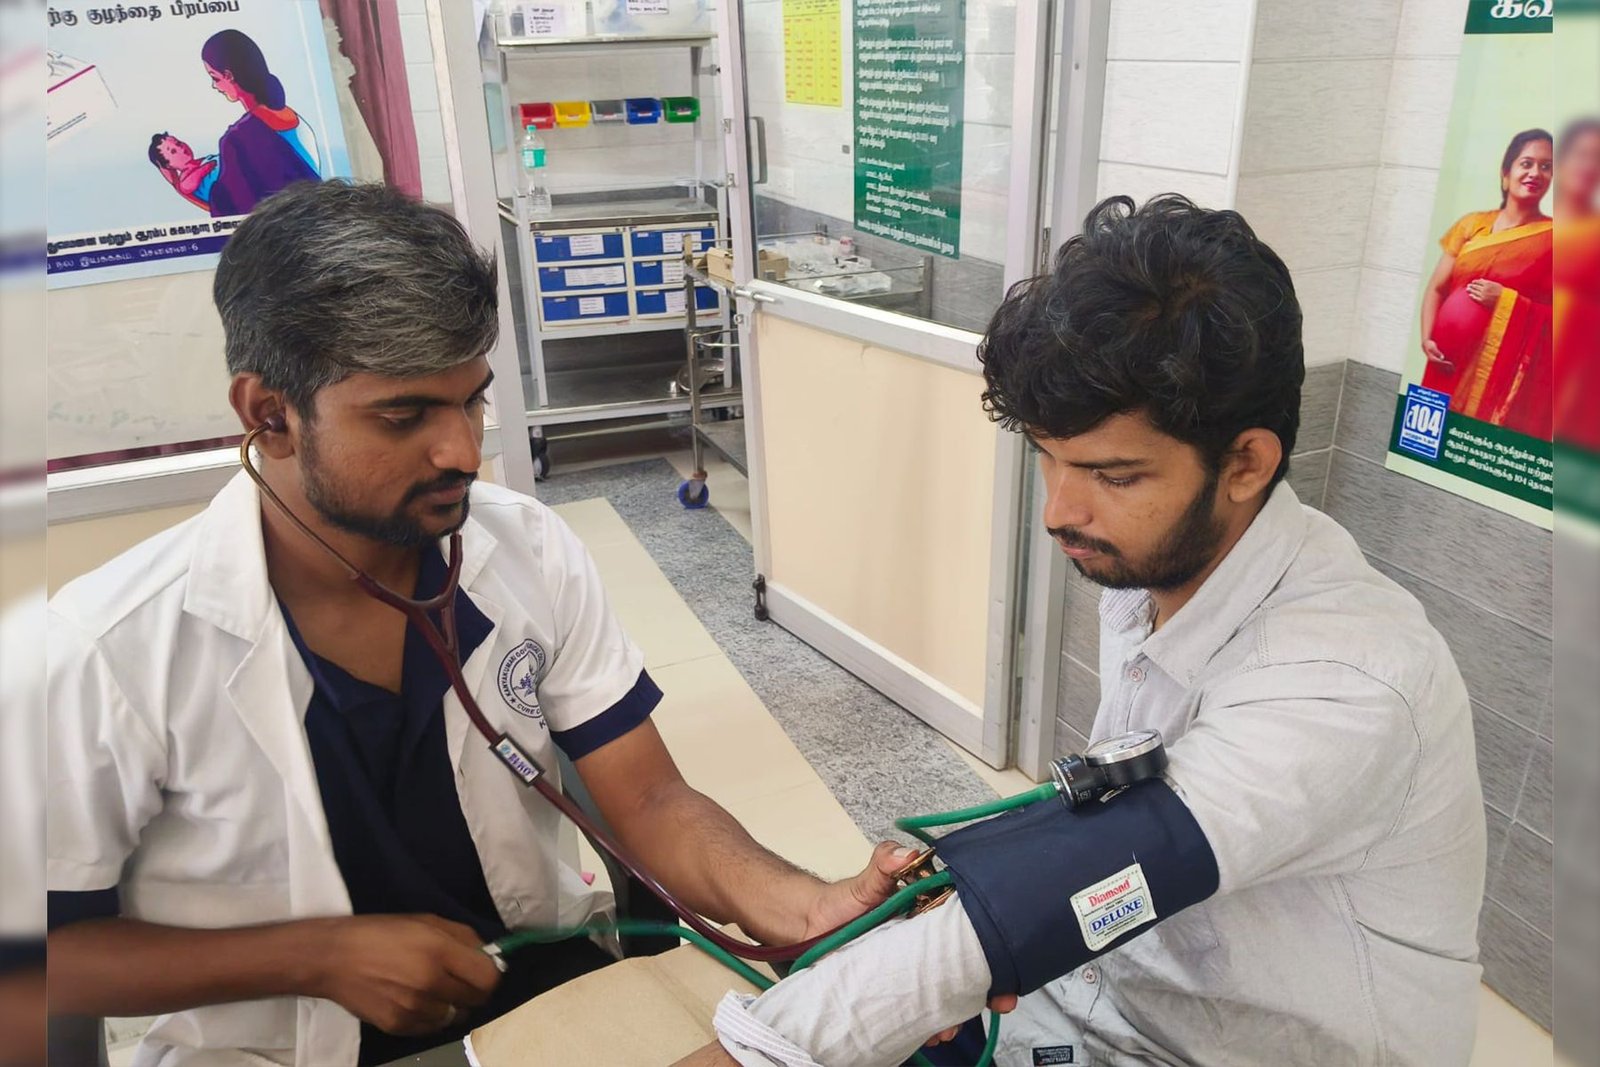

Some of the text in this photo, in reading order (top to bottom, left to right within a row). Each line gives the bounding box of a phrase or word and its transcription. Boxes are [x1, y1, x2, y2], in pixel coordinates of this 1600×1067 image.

[86, 4, 162, 25] குழந்தை
[1410, 403, 1442, 437] 104
[1088, 879, 1131, 907] Diamond
[1091, 898, 1143, 931] DELUXE
